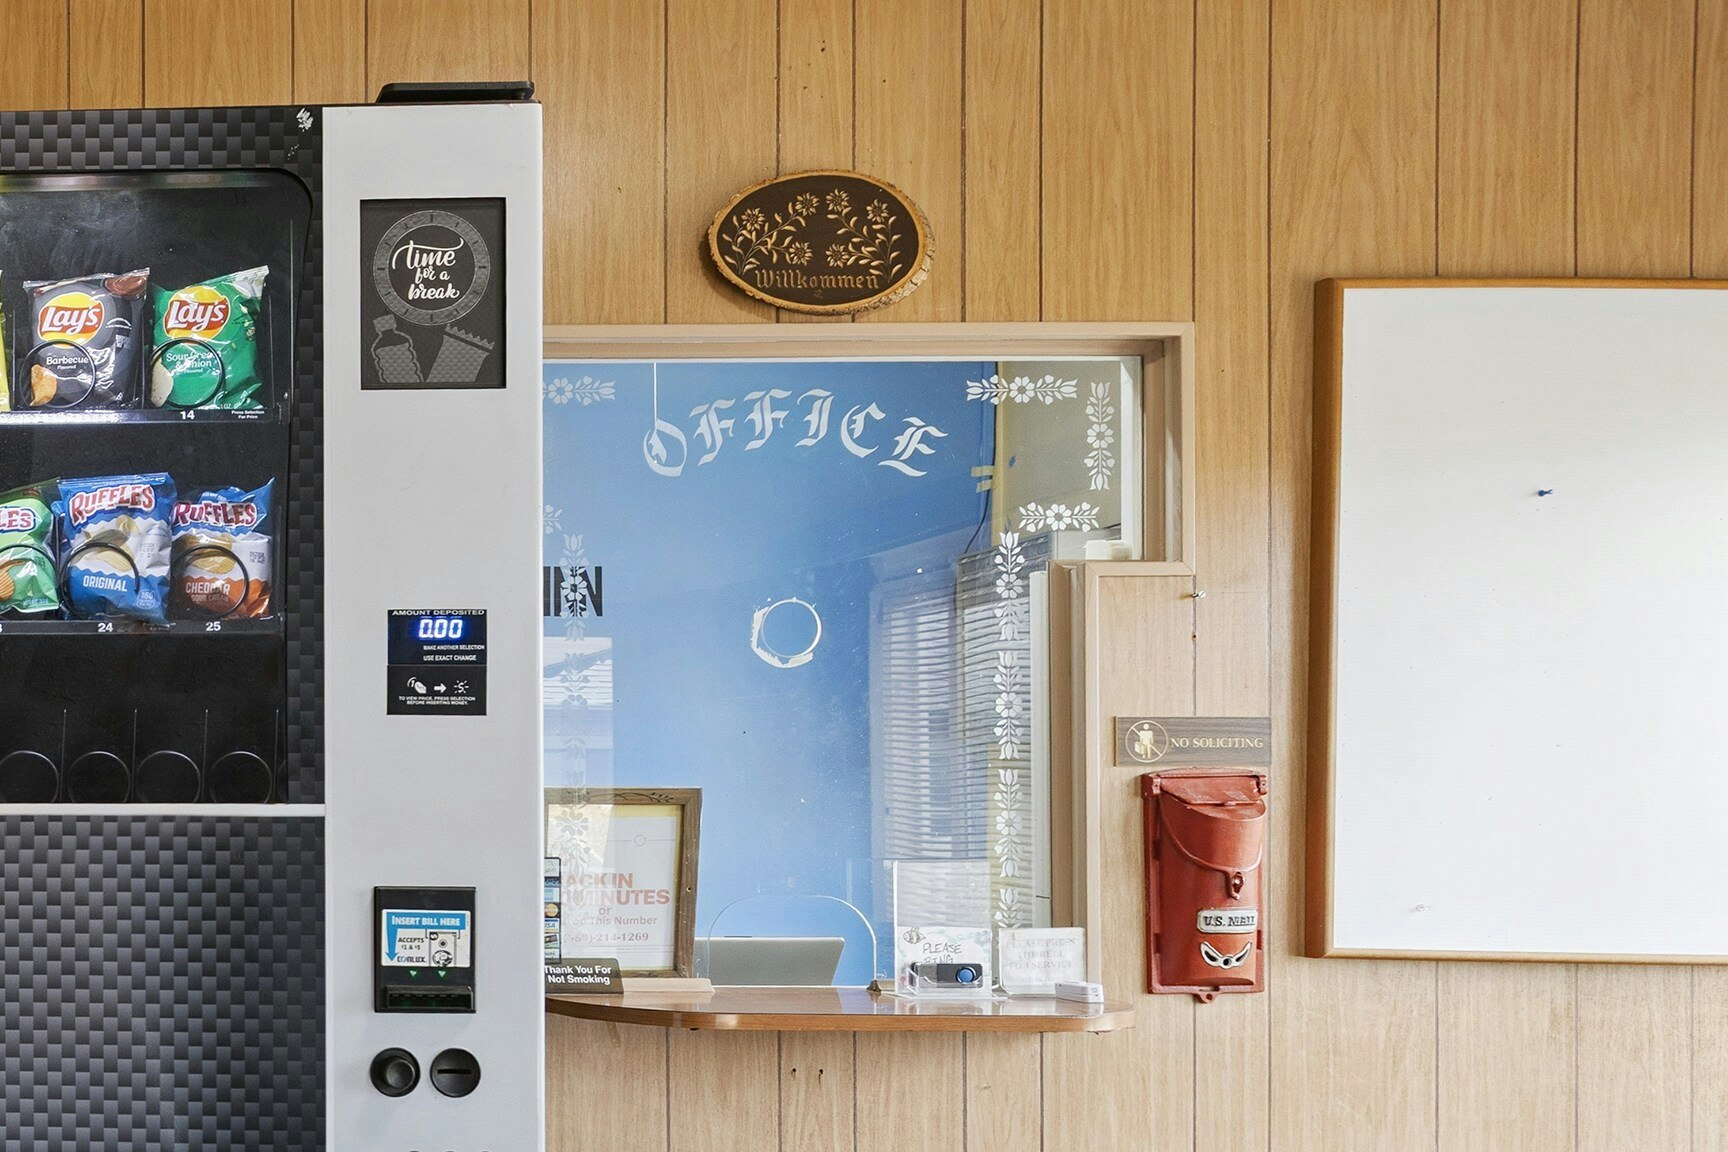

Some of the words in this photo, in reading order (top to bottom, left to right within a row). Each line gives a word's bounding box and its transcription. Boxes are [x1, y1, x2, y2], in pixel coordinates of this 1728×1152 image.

[415, 265, 436, 284] for
[439, 270, 451, 281] a
[754, 269, 880, 290] Willkommen
[407, 283, 460, 300] break
[41, 306, 101, 336] Lay's
[167, 301, 227, 332] Lay's
[46, 356, 90, 365] Barbecue
[166, 352, 189, 362] Sour
[180, 410, 195, 420] 14
[643, 388, 949, 477] OFFICE
[70, 484, 154, 525] RUFFLES
[173, 502, 256, 526] RUFFLES
[83, 575, 128, 592] ORIGINAL
[98, 622, 114, 633] 24
[206, 621, 222, 632] 25
[419, 619, 463, 639] 0.00
[1171, 738, 1189, 748] NO
[1192, 738, 1264, 749] SOLICITING
[564, 873, 605, 887] ACK
[612, 873, 633, 889] IN
[599, 908, 611, 916] or
[391, 916, 420, 926] INSERT
[421, 917, 439, 926] BILL
[440, 918, 460, 926] HERE
[614, 916, 658, 926] Number
[922, 942, 963, 955] PLEASE
[544, 966, 574, 975] Thank
[575, 966, 593, 974] You
[595, 966, 612, 974] For
[547, 975, 566, 984] Not
[567, 975, 611, 986] Smoking
